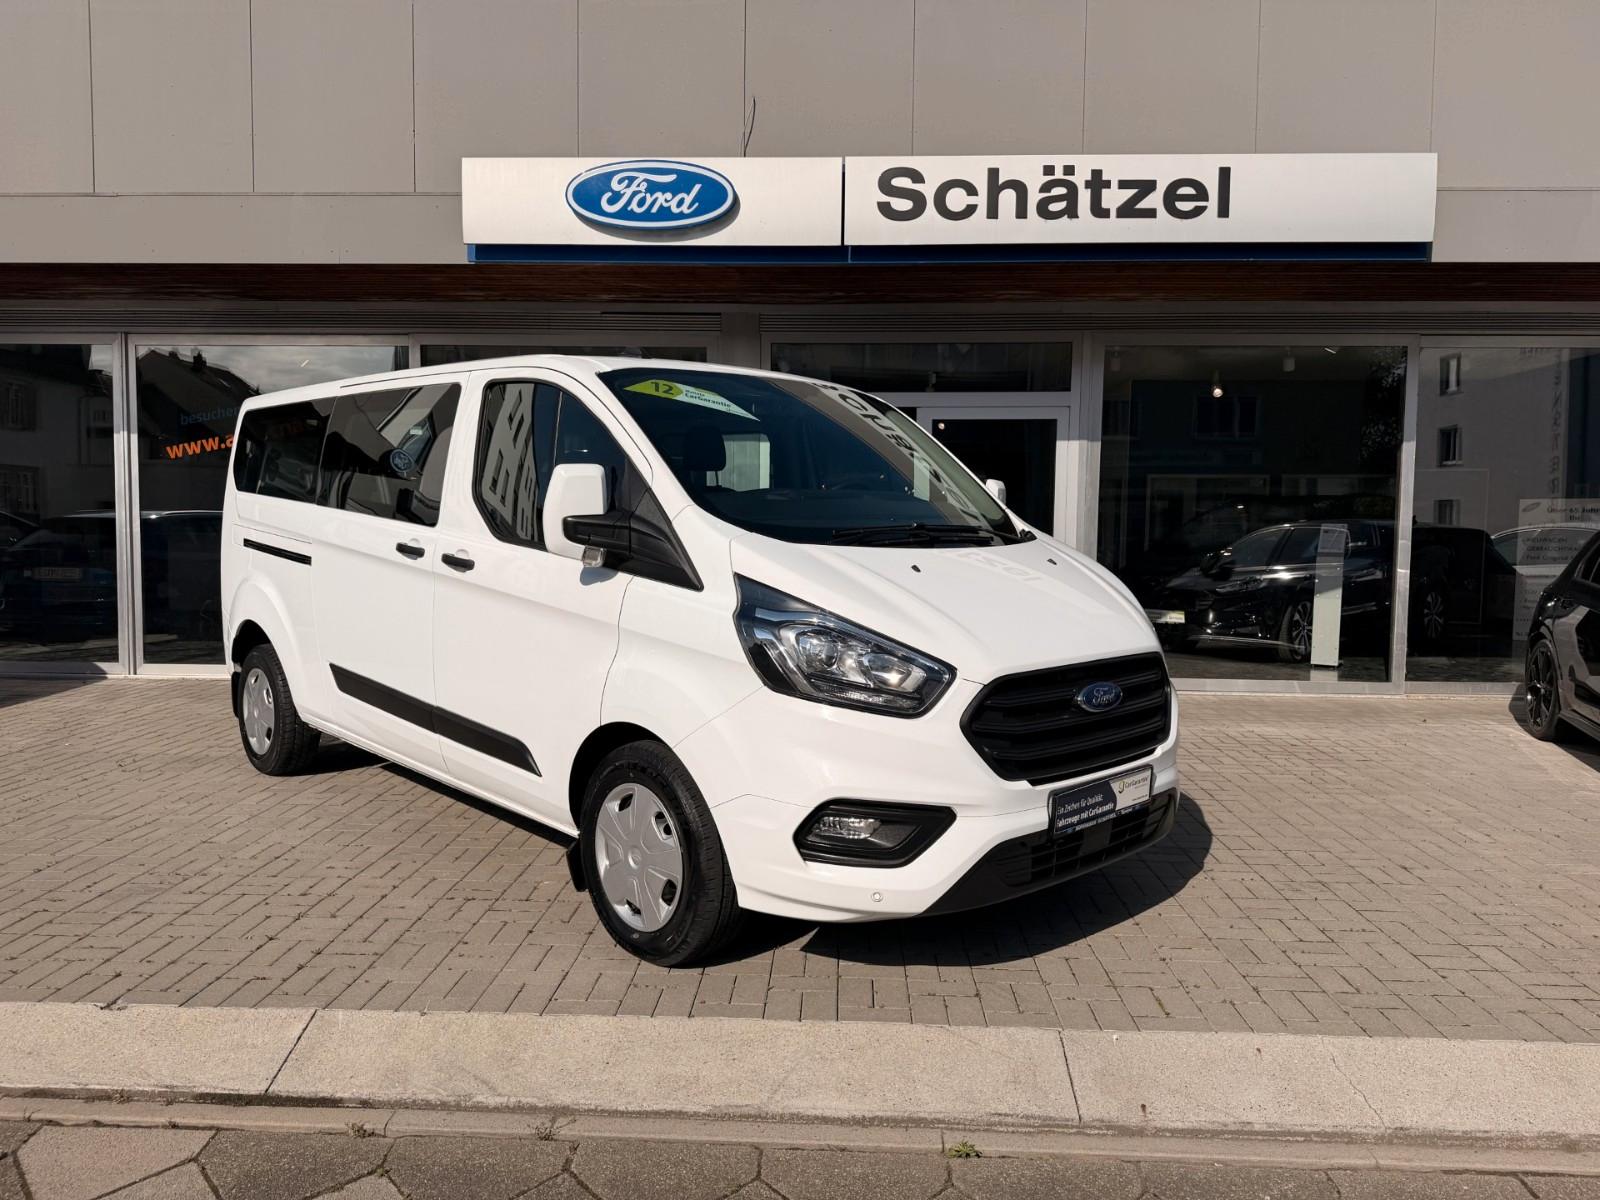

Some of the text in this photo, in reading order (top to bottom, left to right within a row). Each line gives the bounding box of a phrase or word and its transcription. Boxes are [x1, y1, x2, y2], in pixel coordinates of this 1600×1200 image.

[600, 171, 703, 214] Ford
[876, 164, 1231, 222] Schätzel
[650, 381, 674, 395] 12
